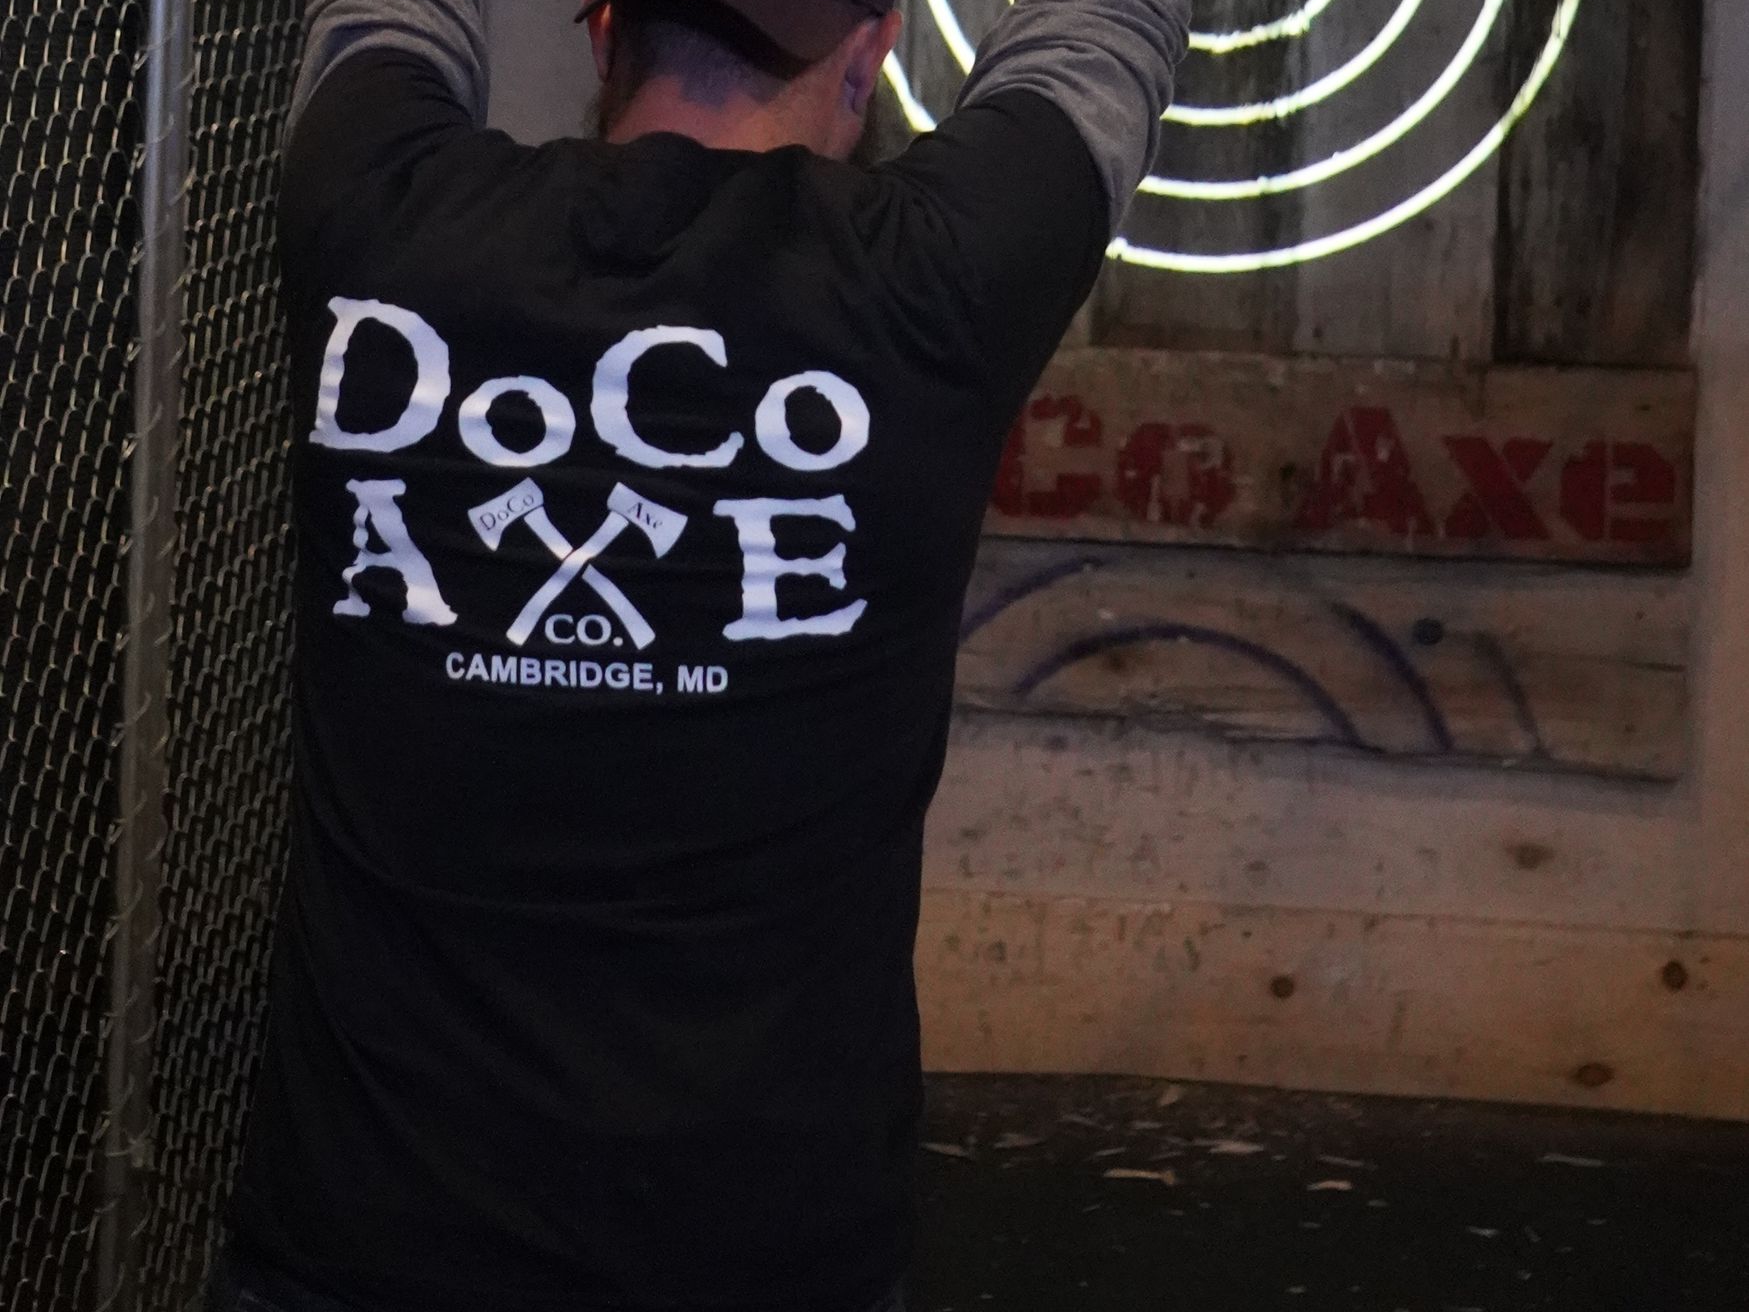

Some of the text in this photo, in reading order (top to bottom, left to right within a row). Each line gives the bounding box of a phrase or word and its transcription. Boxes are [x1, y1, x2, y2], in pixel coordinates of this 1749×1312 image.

[310, 296, 870, 471] DoCo
[479, 492, 535, 531] DoCo
[627, 501, 663, 530] Axe
[544, 614, 624, 646] CO.
[446, 652, 728, 695] CAMBRIDGE, MD
